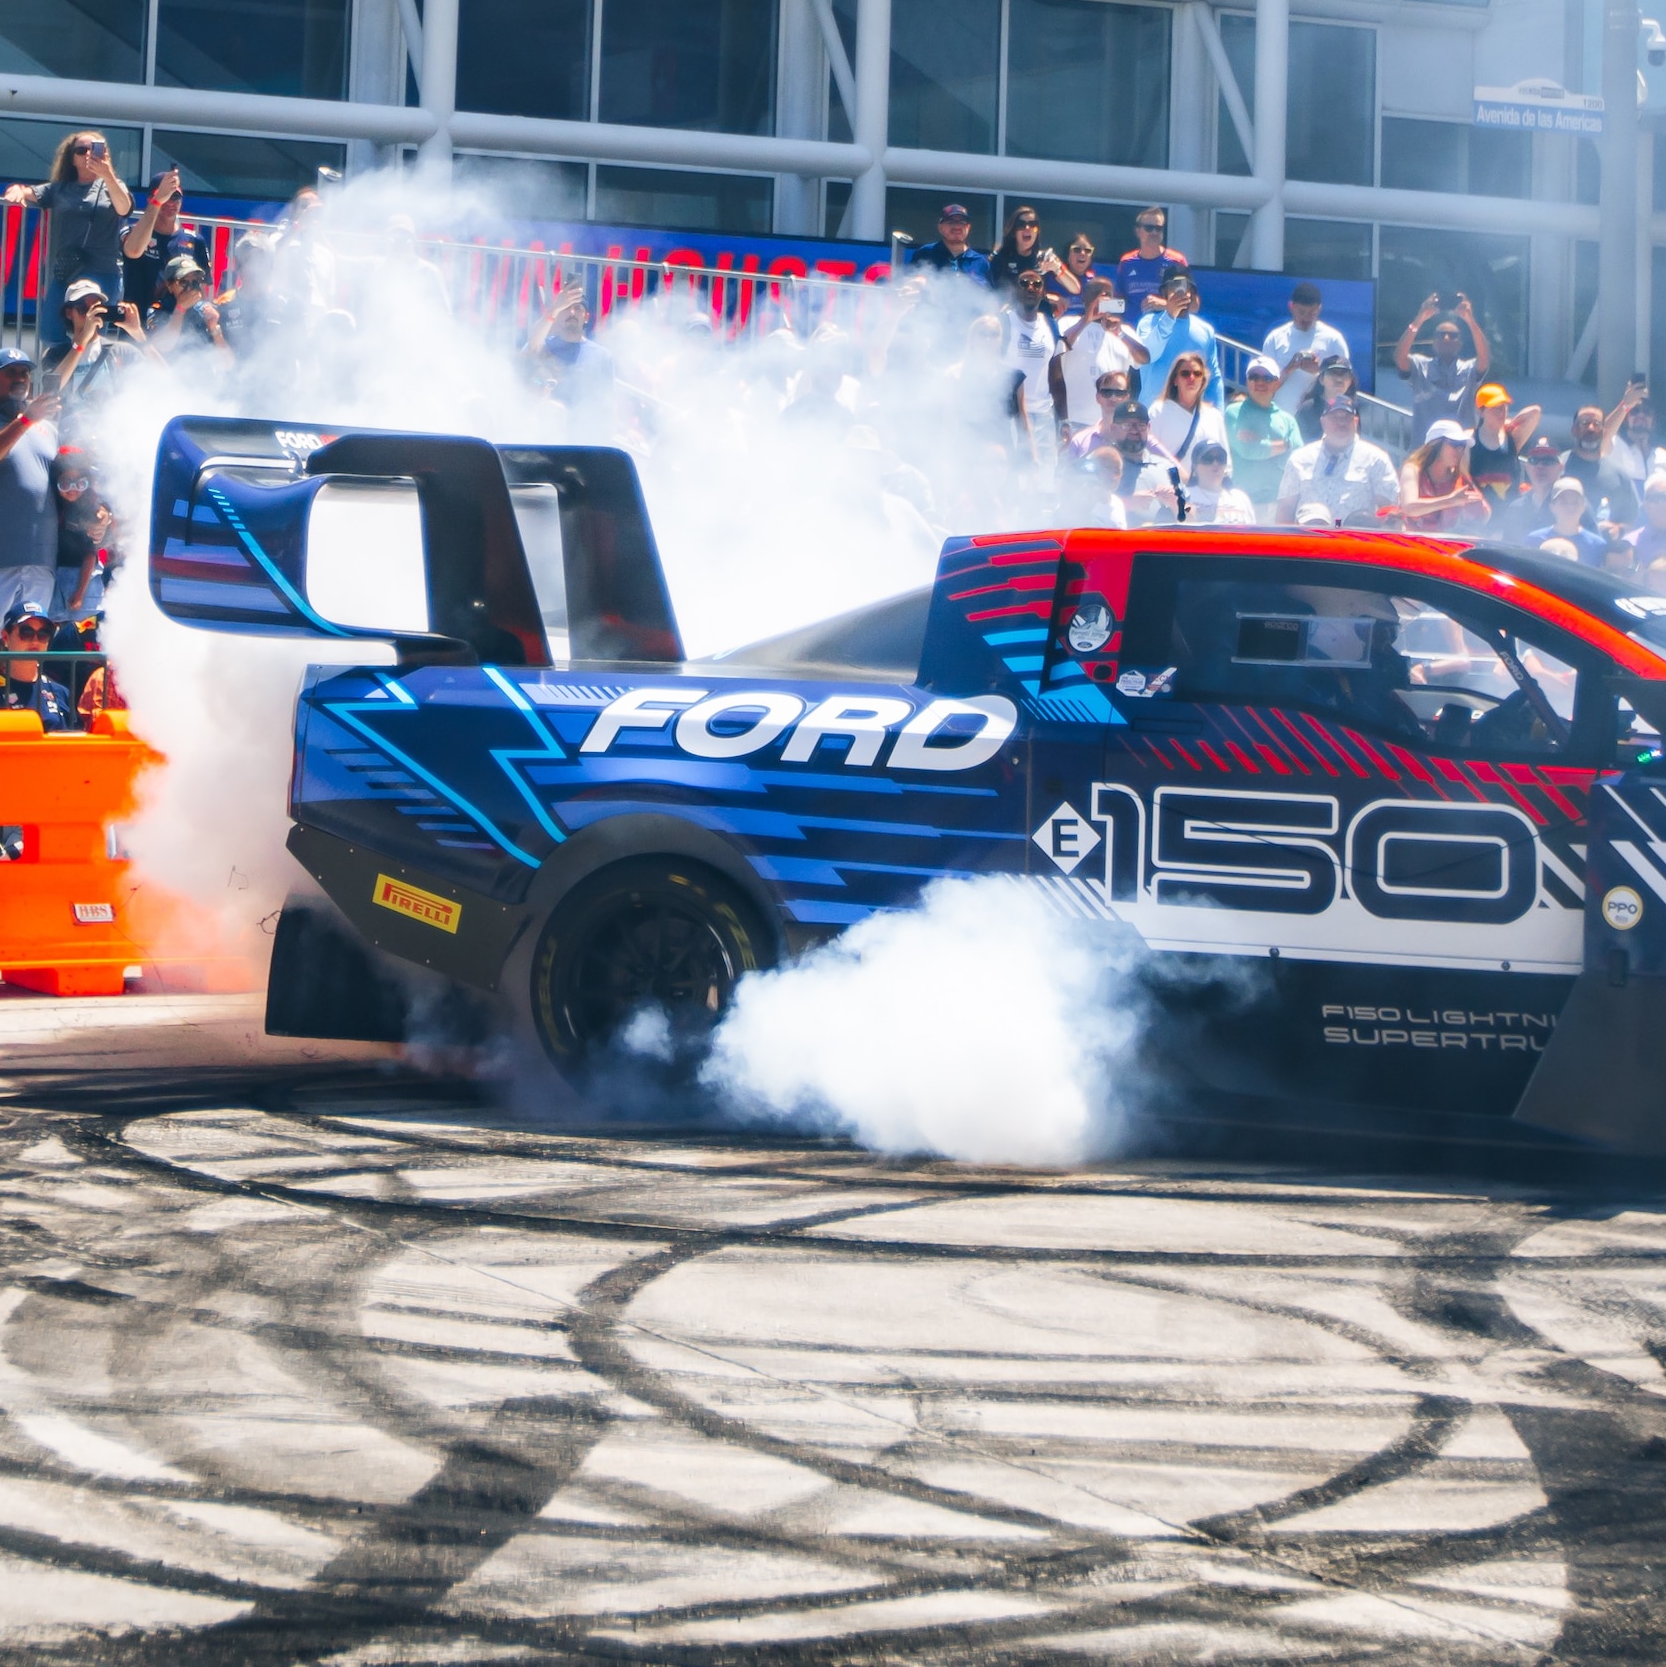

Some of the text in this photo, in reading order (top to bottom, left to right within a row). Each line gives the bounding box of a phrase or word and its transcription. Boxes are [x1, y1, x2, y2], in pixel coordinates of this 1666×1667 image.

[1583, 98, 1603, 109] 1200
[1477, 105, 1603, 133] Avenida de las Americas
[275, 431, 322, 450] FORD
[580, 688, 1019, 772] FORD
[1051, 782, 1544, 925] E 150
[381, 882, 453, 926] PIRELLI
[1607, 901, 1638, 915] PPO
[1322, 1005, 1557, 1028] F150 LIGHTNI
[1323, 1027, 1546, 1052] SUPERTRU
